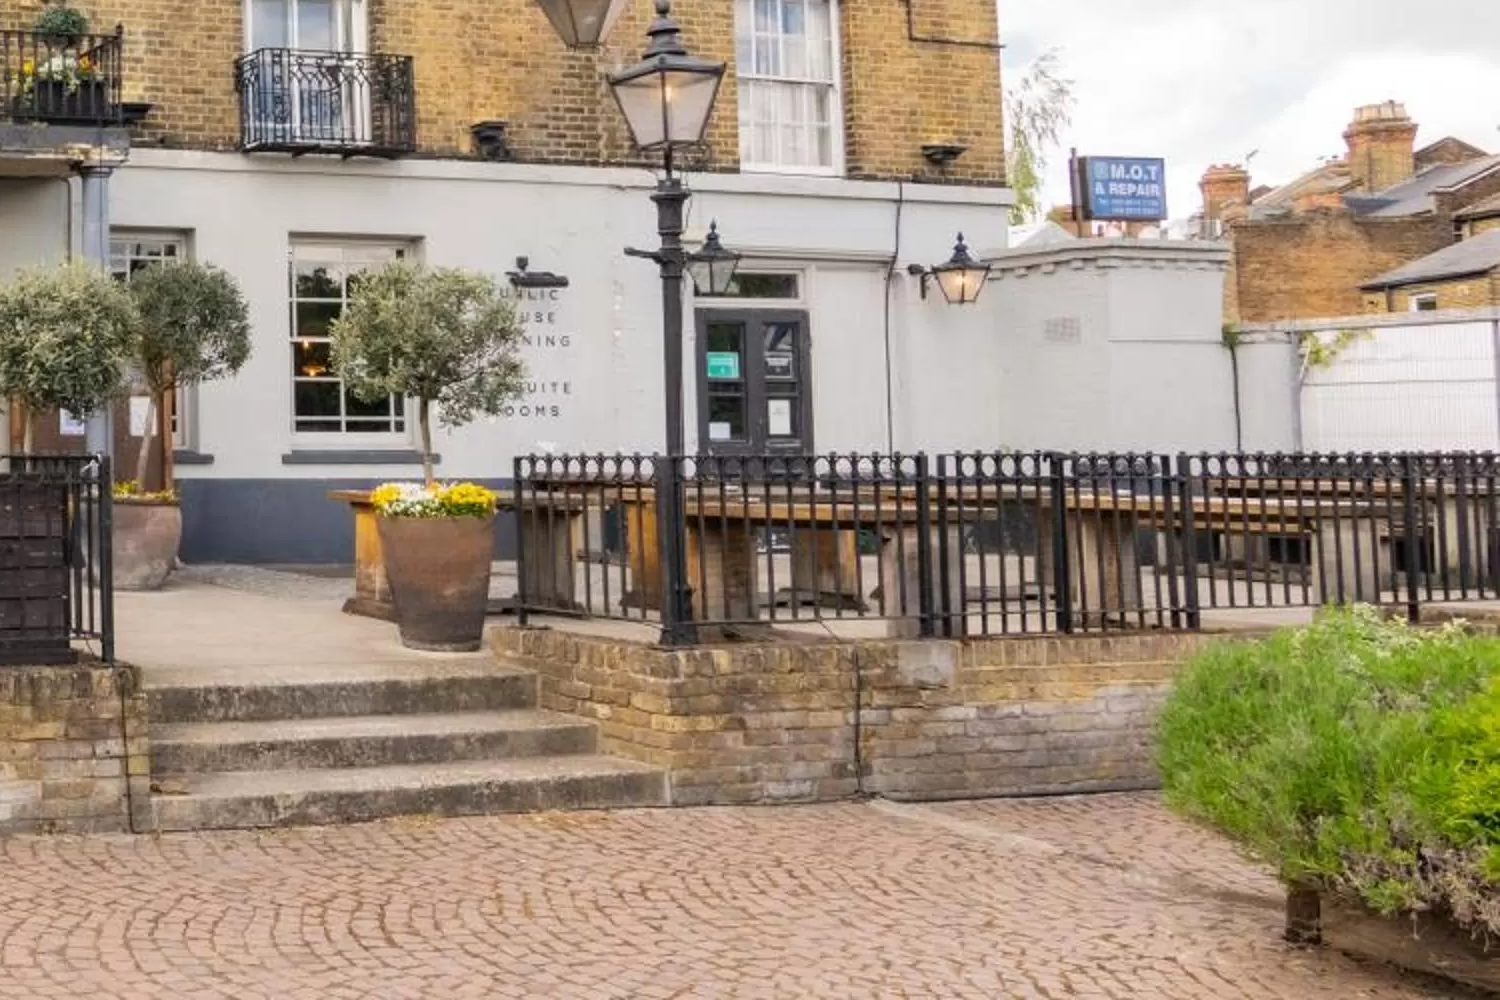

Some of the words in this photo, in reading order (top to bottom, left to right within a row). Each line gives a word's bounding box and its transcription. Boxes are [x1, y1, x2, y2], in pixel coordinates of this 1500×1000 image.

[1108, 182, 1160, 197] REPAIR
[488, 287, 560, 300] ULIC
[511, 311, 556, 324] USE
[513, 335, 570, 347] NING
[503, 405, 560, 417] OOMS
